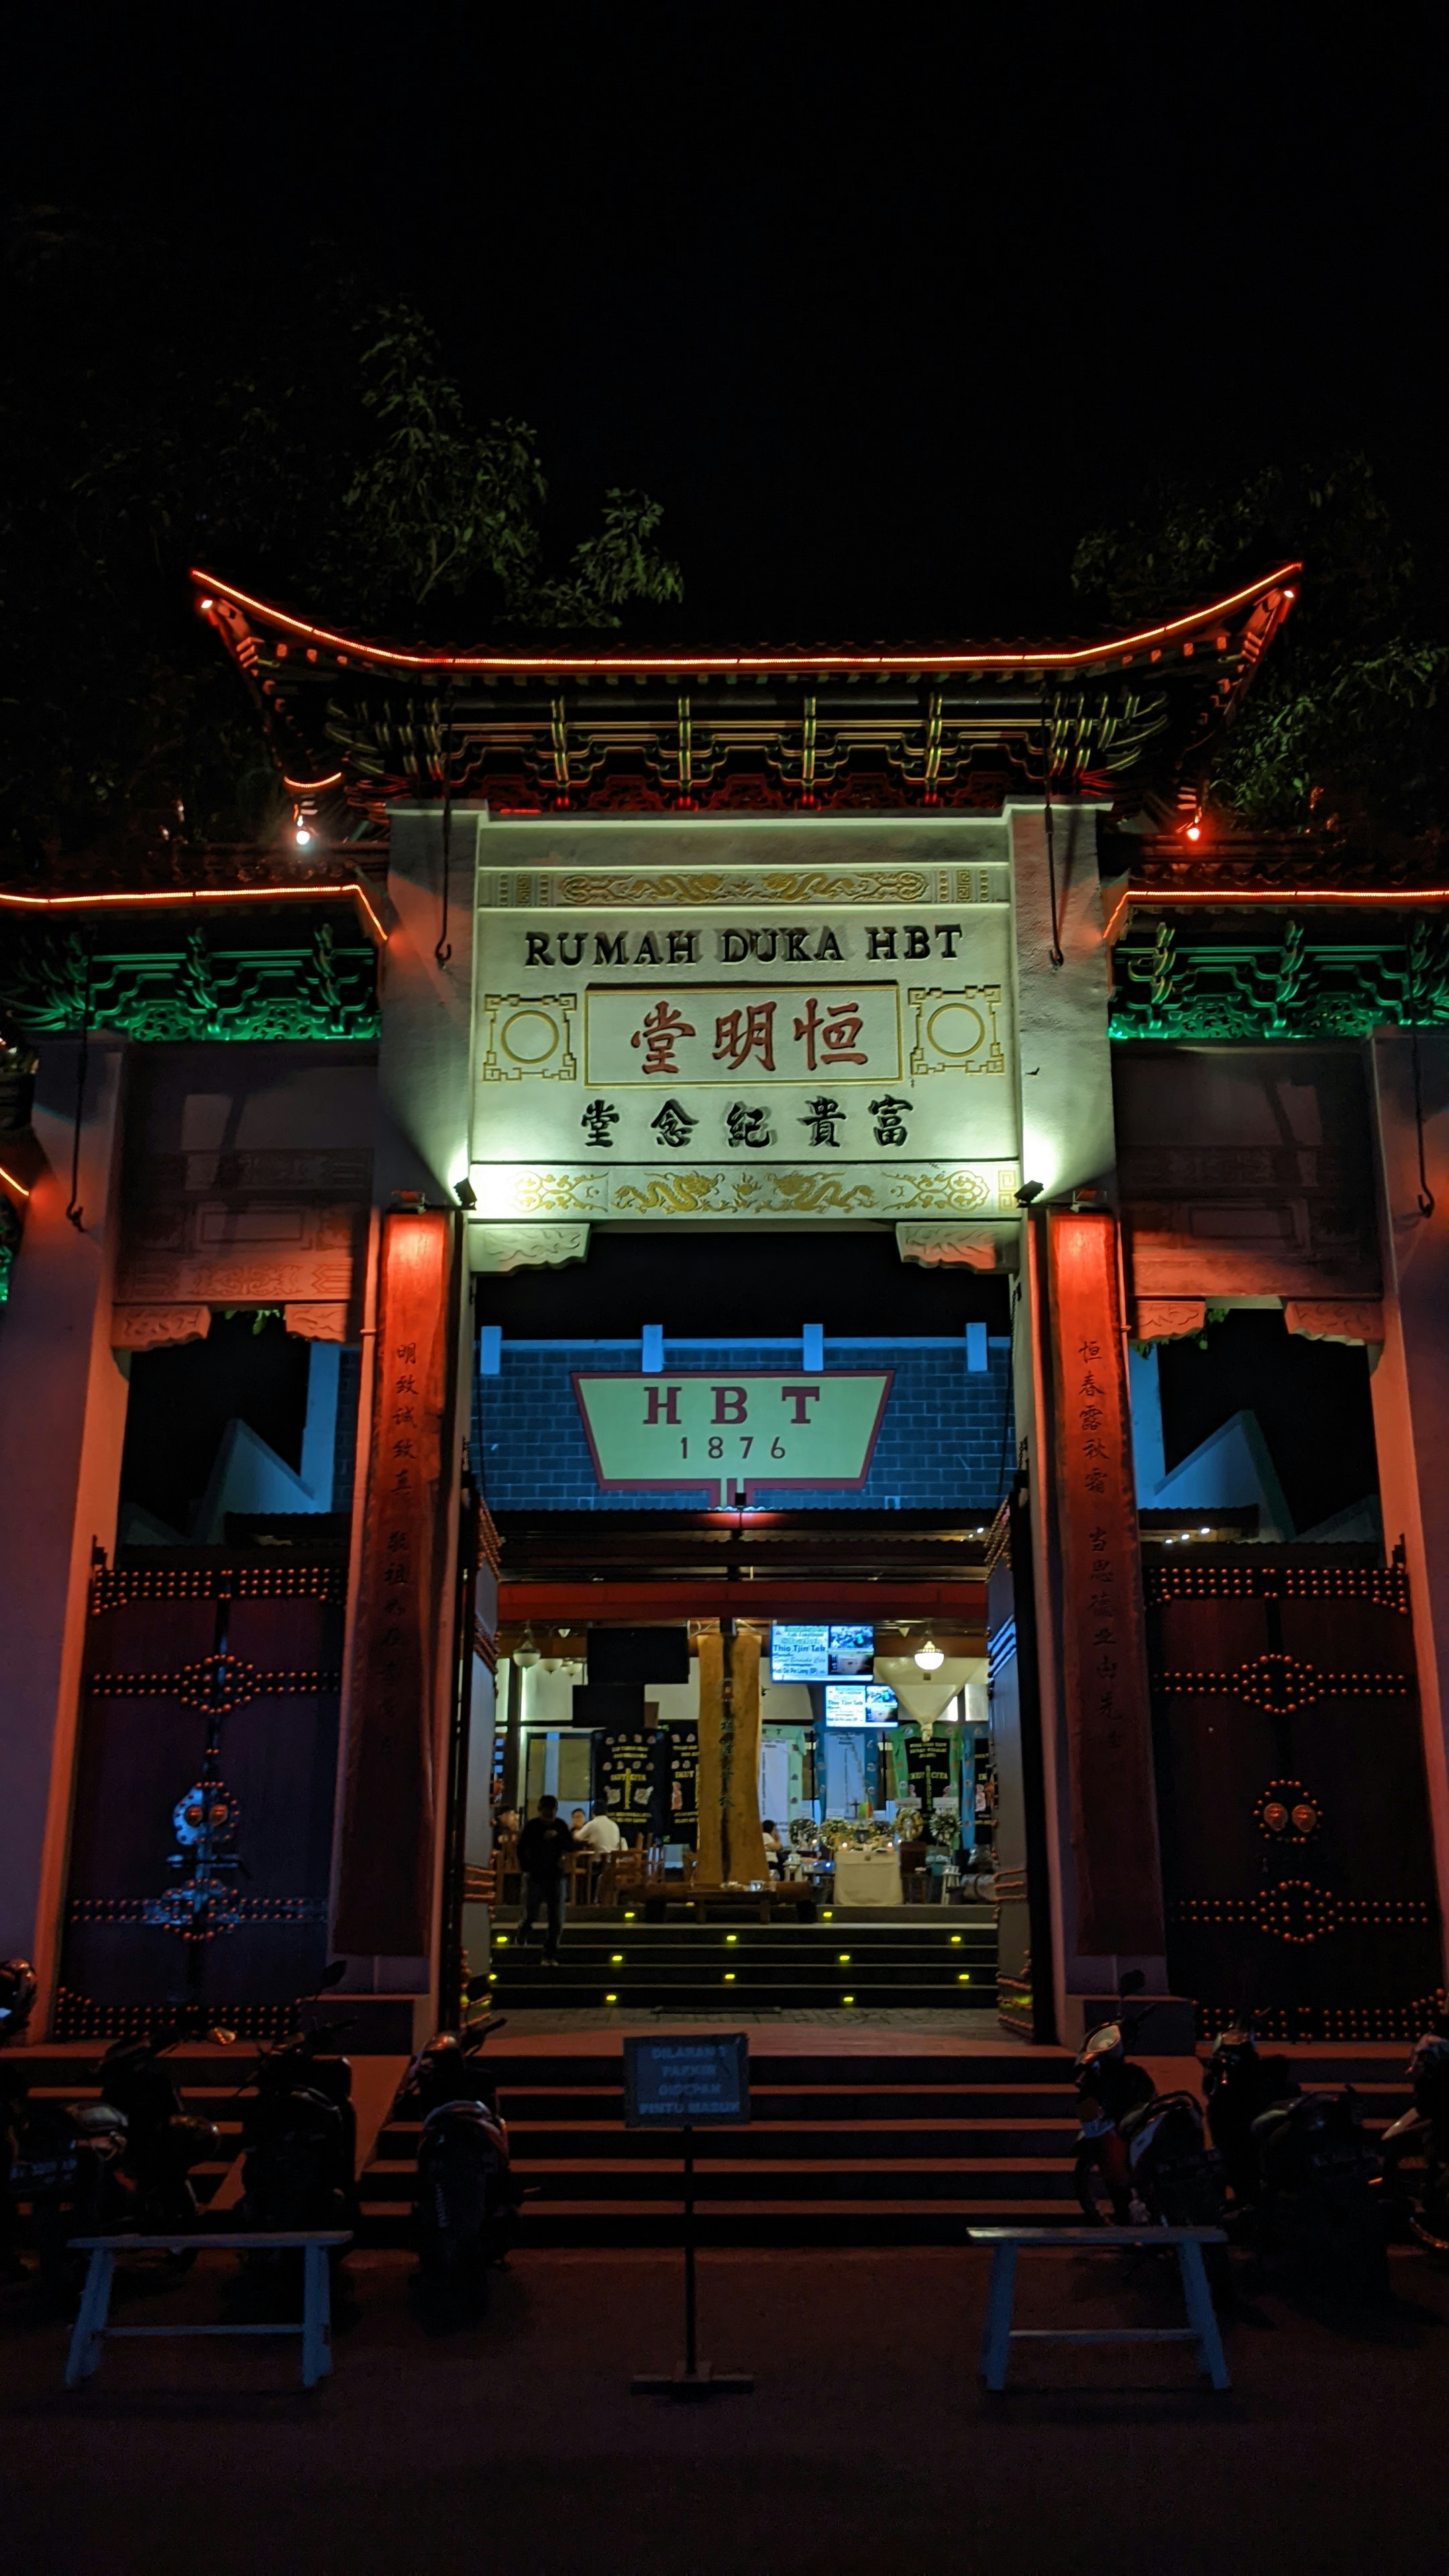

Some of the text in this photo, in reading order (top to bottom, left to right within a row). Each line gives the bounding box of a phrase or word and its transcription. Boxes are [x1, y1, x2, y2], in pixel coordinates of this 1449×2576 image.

[525, 924, 963, 967] RUMAH DUKA HBT
[643, 1386, 820, 1425] HBT
[680, 1436, 786, 1460] 1876
